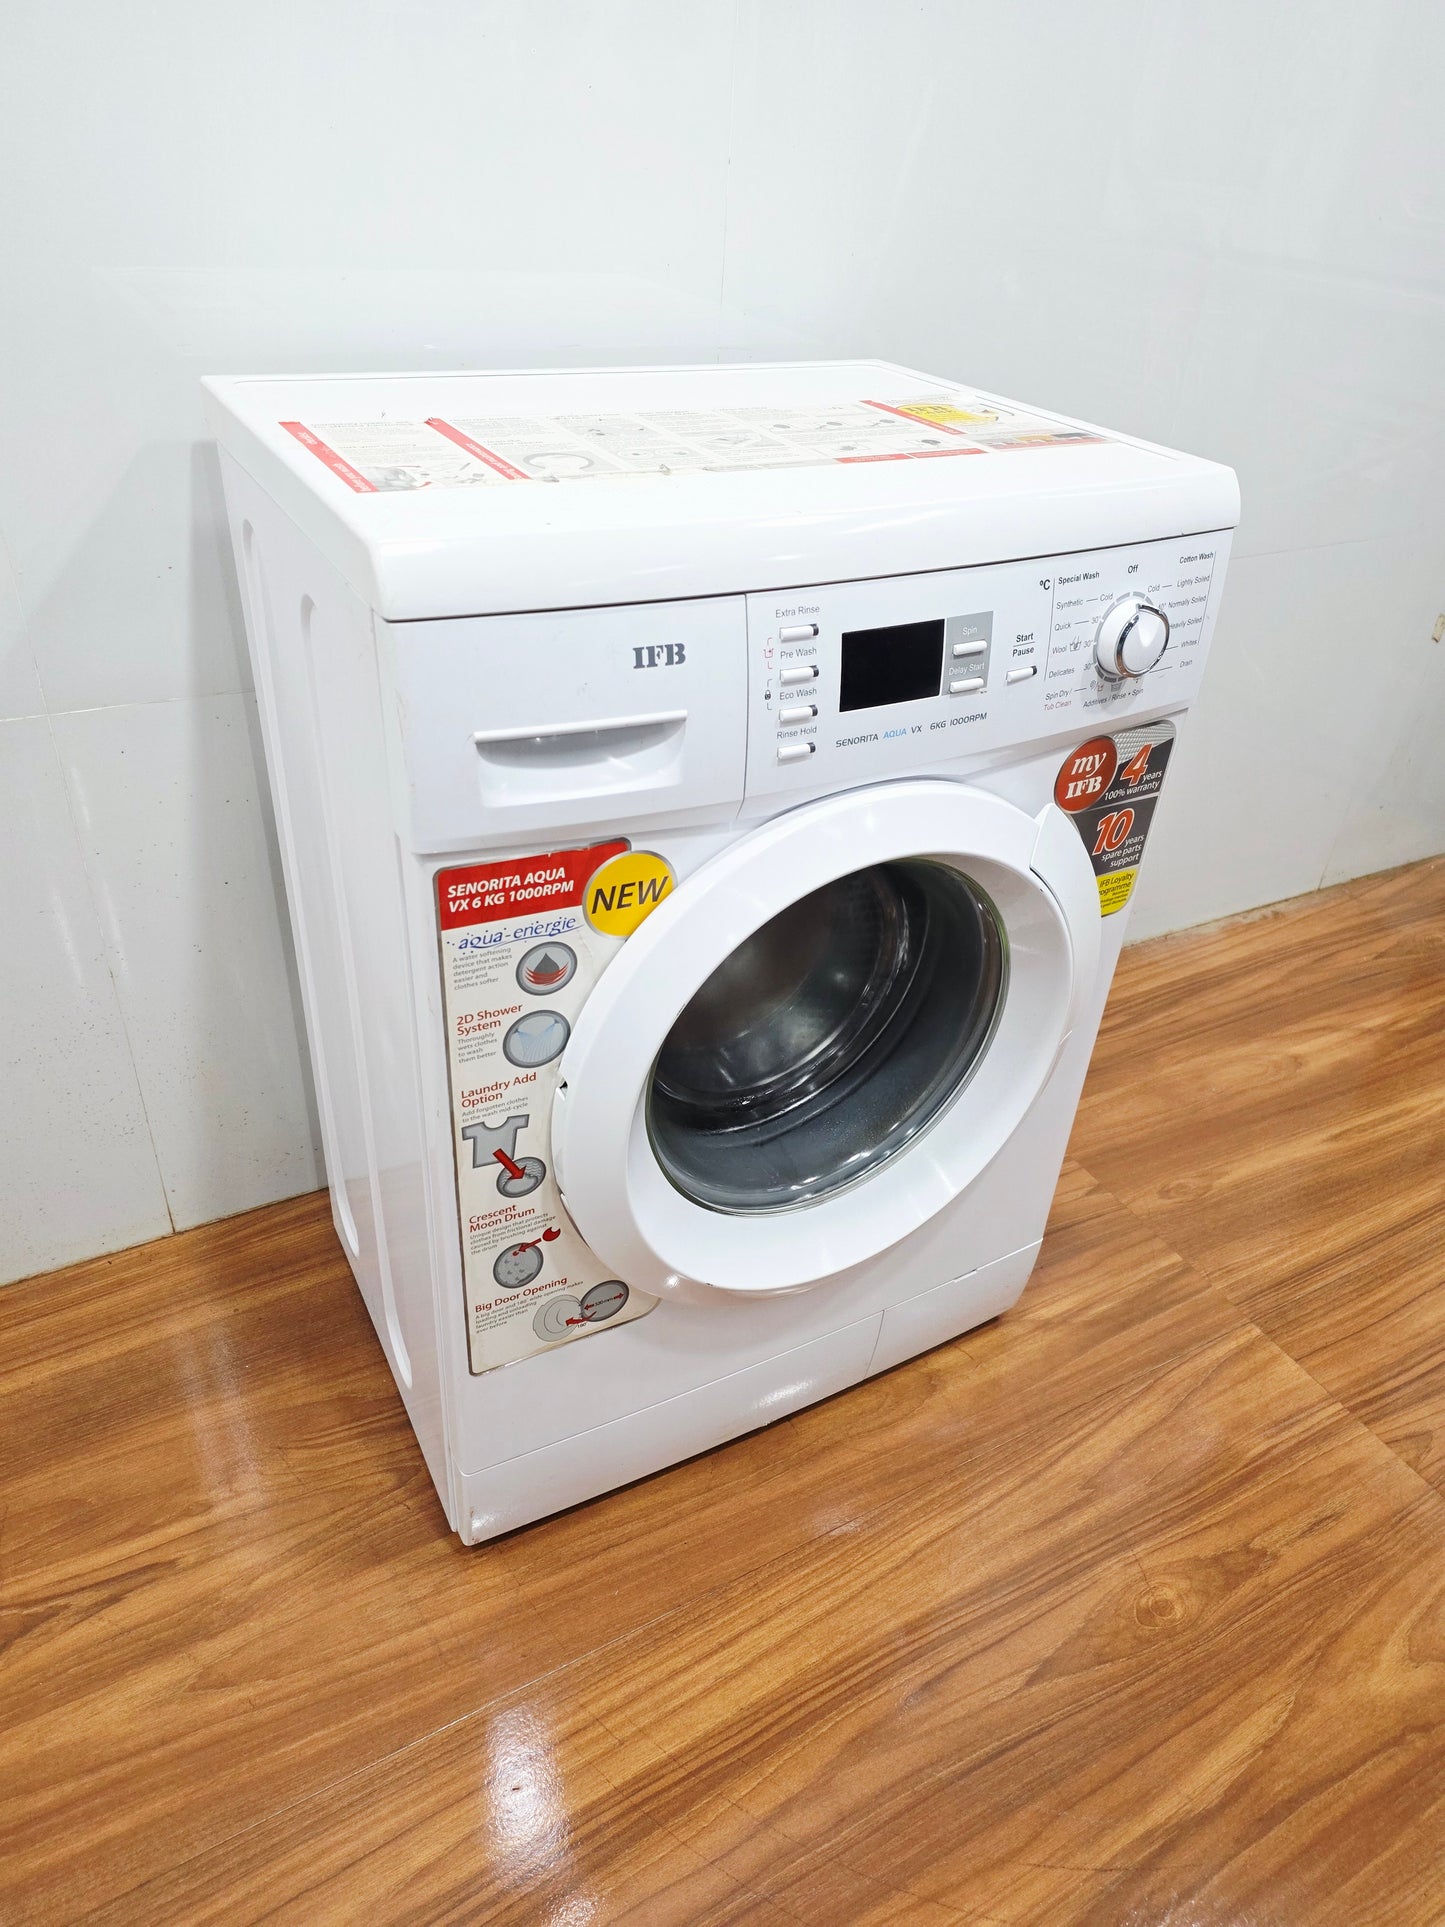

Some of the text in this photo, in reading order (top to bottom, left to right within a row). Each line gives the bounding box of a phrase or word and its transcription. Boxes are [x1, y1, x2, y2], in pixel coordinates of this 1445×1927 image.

[1180, 552, 1214, 564] Cotton Wash
[1128, 564, 1138, 574] Off
[1058, 571, 1100, 585] Special Wash
[1148, 575, 1210, 593] Cold Lightly Soiled
[1056, 593, 1113, 610] Synthetic Cold
[1169, 599, 1190, 609] Normally
[1191, 595, 1206, 604] Soiled
[776, 606, 820, 618] Extra Rinse
[1055, 622, 1071, 631] Quick
[1170, 617, 1202, 629] eavily Soiled
[963, 626, 978, 636] Spin
[1016, 632, 1034, 642] Start
[632, 643, 686, 669] IFB
[780, 648, 817, 659] Pre Wash
[1013, 647, 1034, 657] Pause
[1052, 645, 1067, 654] Wool
[949, 662, 985, 676] Delay Start
[1180, 660, 1192, 668] Drain
[1049, 667, 1075, 678] Delicates
[780, 688, 817, 700] Eco Wash
[1045, 691, 1058, 701] Spin
[1083, 697, 1107, 708] Additives
[1112, 692, 1127, 701] Rinse
[1132, 689, 1144, 697] Spin
[1044, 700, 1071, 711] Tub Clean
[777, 726, 817, 739] Rinse Hold
[836, 712, 987, 748] SENORITA AQUA VX 6KG 1000RPM
[1071, 752, 1107, 777] my
[1120, 743, 1162, 787] 4 years
[1065, 776, 1102, 799] IFB
[1105, 781, 1160, 800] 100% warranty
[1092, 808, 1144, 855] 10 years
[1102, 844, 1142, 862] spare parts
[1110, 854, 1139, 868] support
[447, 867, 566, 898] SENORITA AQUA
[1111, 873, 1134, 885] Loyalty
[449, 880, 574, 912] VX 6 KG 1000RPM
[592, 876, 669, 914] NEW
[480, 948, 511, 958] softening
[453, 962, 474, 970] device
[491, 954, 512, 962] makes
[453, 962, 509, 977] detergent action
[454, 978, 499, 990] clothes softer
[457, 1004, 523, 1026] 2D Shower
[457, 1020, 501, 1036] System
[458, 1032, 495, 1044] Thoroughly
[474, 1038, 497, 1047] clothes
[467, 1048, 483, 1056] wash
[477, 1051, 496, 1060] better
[462, 1072, 536, 1099] Laundry Add
[462, 1092, 502, 1108] Option
[477, 1102, 505, 1113] forgotten
[507, 1097, 528, 1105] clothes
[469, 1205, 517, 1224] Crescent
[470, 1208, 535, 1232] Moon Drum
[534, 1216, 556, 1225] damage
[470, 1230, 492, 1240] Unique
[493, 1223, 512, 1232] design
[525, 1213, 548, 1223] protects
[471, 1242, 491, 1250] caused
[501, 1231, 526, 1241] brushing
[526, 1224, 547, 1233] against
[482, 1244, 498, 1253] drum
[475, 1278, 568, 1314] Big Door Opening
[491, 1306, 505, 1315] door
[507, 1302, 516, 1310] and
[530, 1294, 542, 1302] wide
[543, 1287, 566, 1298] opening
[567, 1281, 584, 1289] makes
[476, 1315, 496, 1325] loading
[510, 1301, 537, 1313] unloading
[476, 1320, 497, 1330] laundry
[490, 1320, 507, 1329] before
